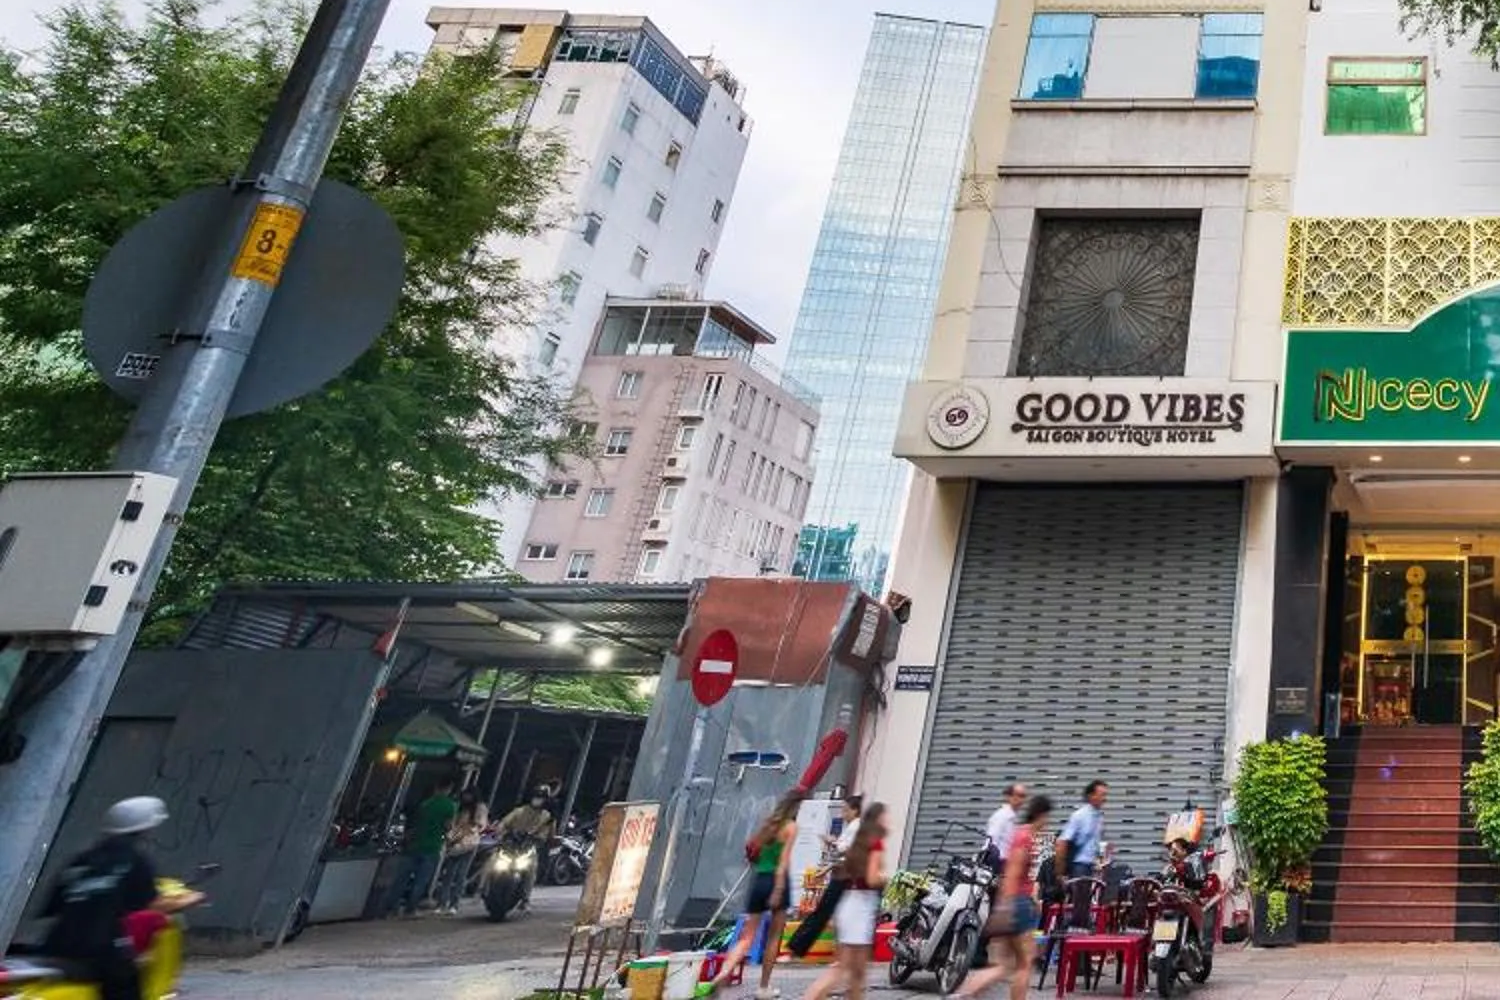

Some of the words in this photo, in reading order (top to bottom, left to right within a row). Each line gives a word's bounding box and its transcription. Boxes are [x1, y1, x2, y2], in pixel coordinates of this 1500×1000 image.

[1015, 392, 1131, 424] GOOD
[1139, 392, 1245, 423] VIBES
[1314, 367, 1490, 423] Nicecy
[1026, 429, 1083, 443] SAIGON
[1086, 429, 1162, 447] BOUTIQUE
[1165, 429, 1216, 443] HOTEL
